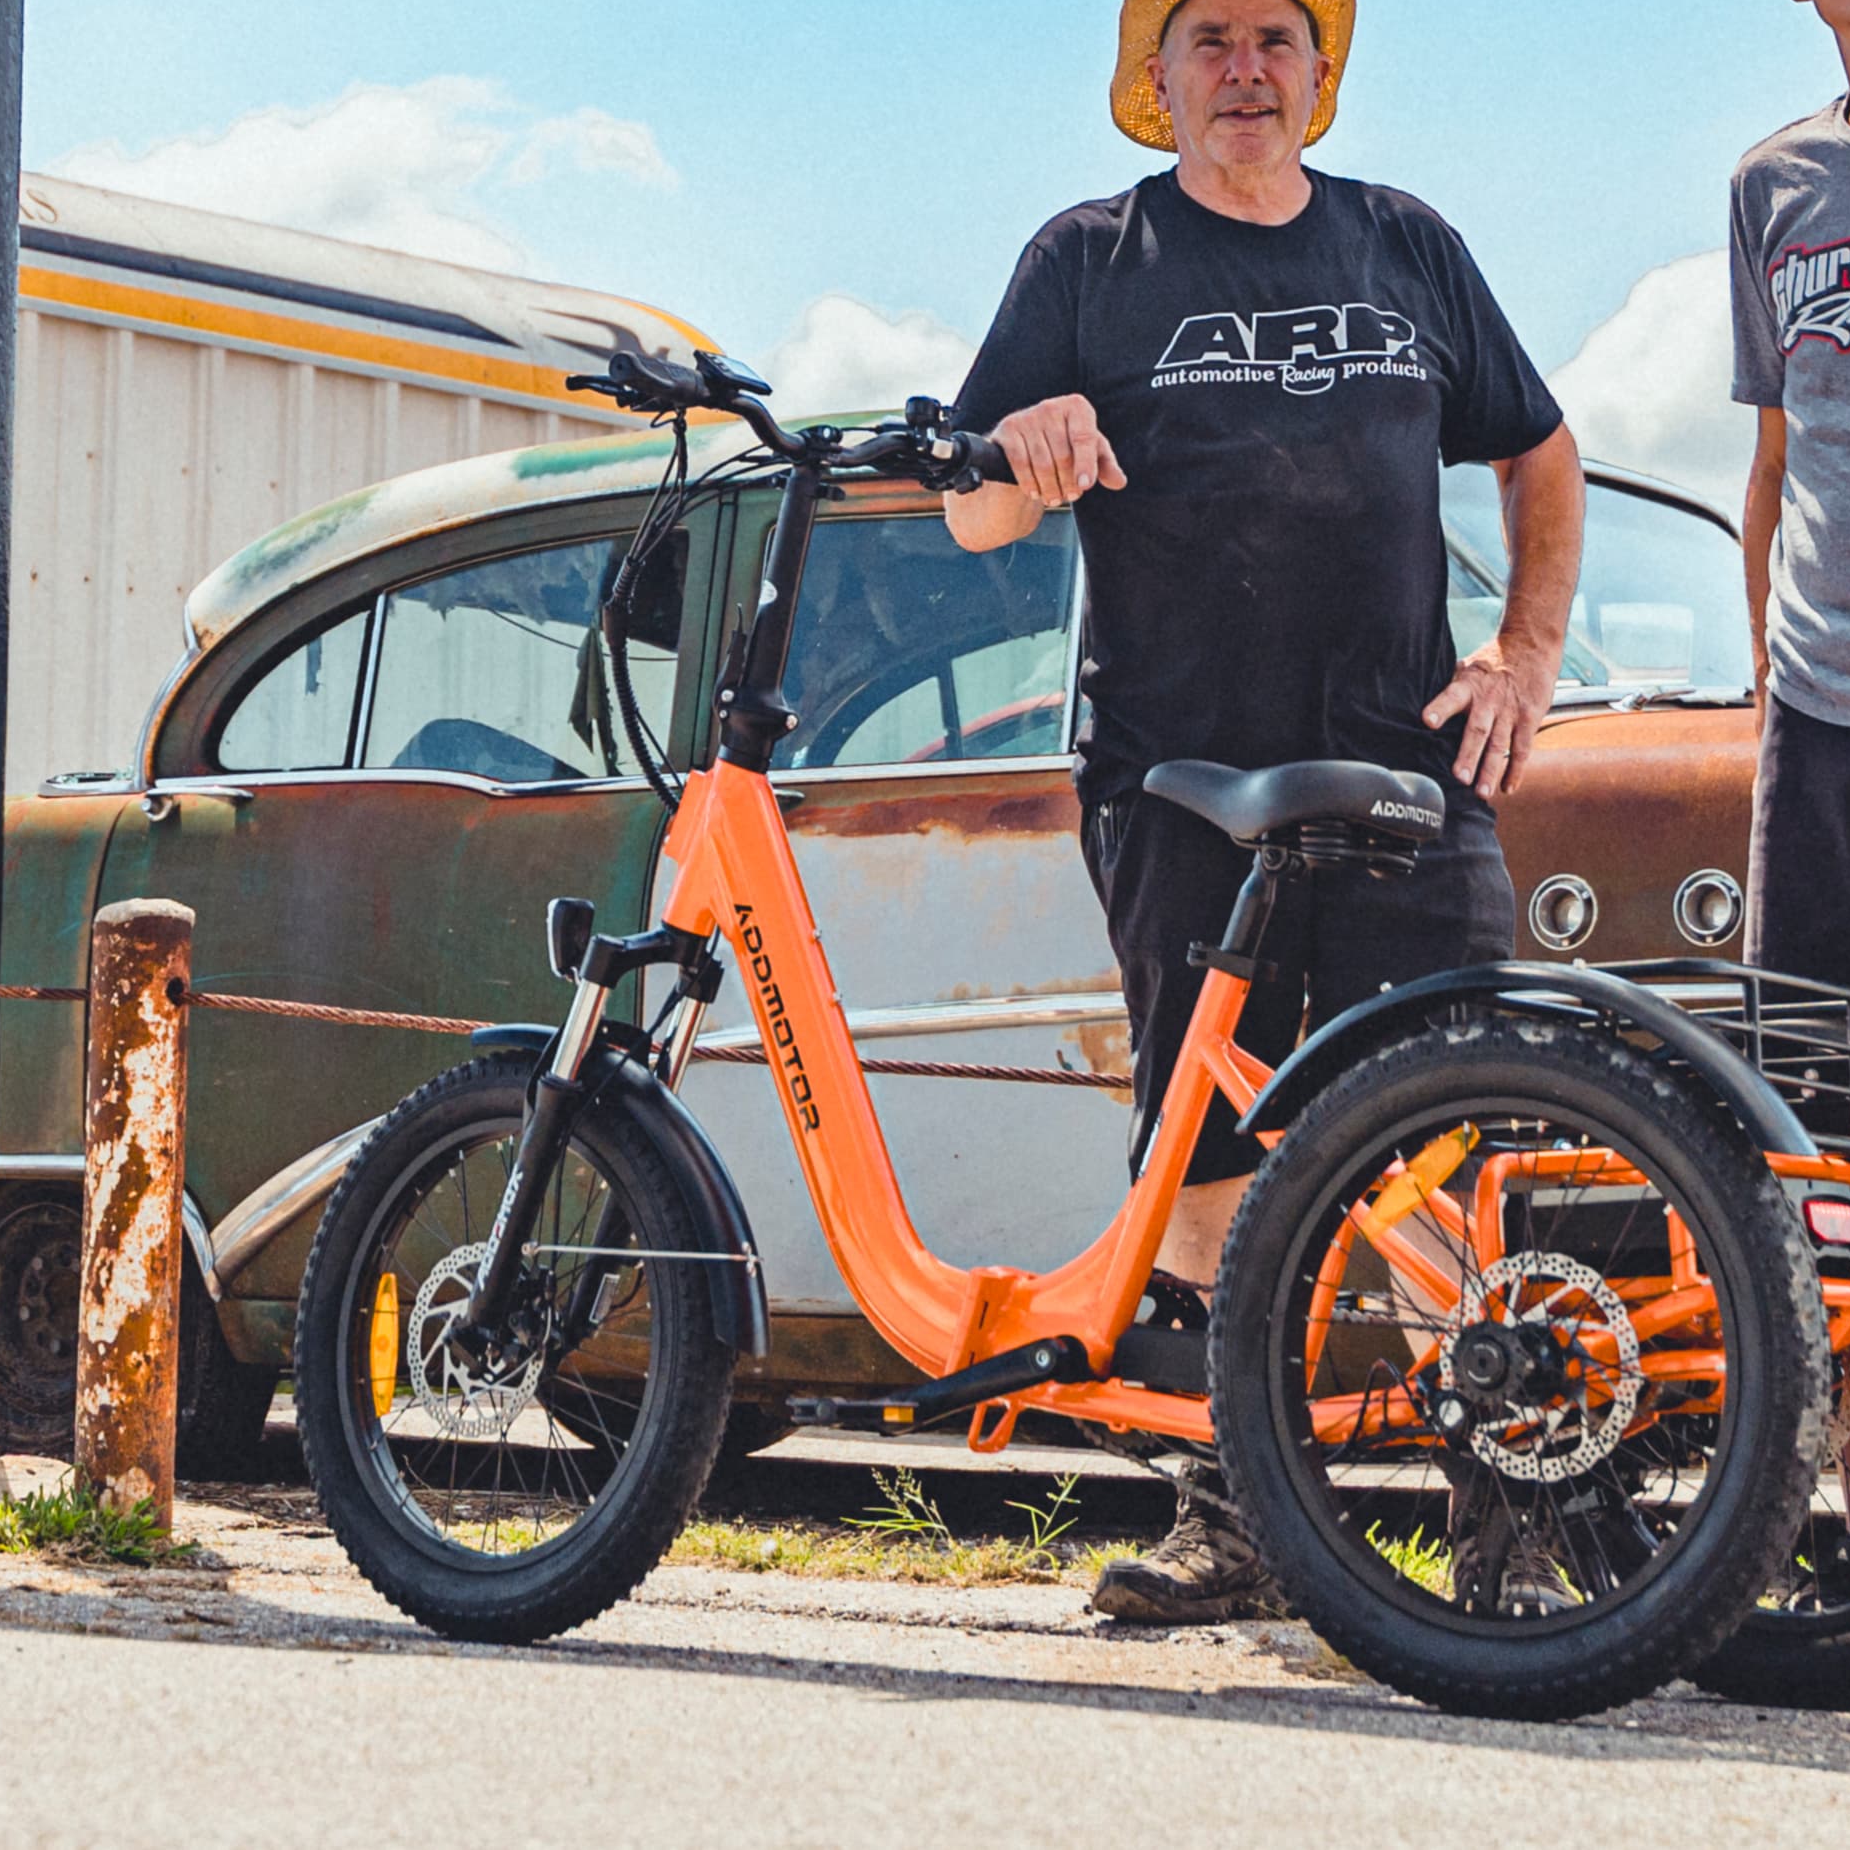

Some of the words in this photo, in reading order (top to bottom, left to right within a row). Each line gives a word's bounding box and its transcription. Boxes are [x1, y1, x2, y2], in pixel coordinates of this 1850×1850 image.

[1154, 303, 1416, 369] ARP
[1151, 365, 1276, 388] automotive
[1278, 363, 1336, 396] Racing
[1341, 356, 1428, 381] products
[733, 902, 821, 1134] ADDMOTOR
